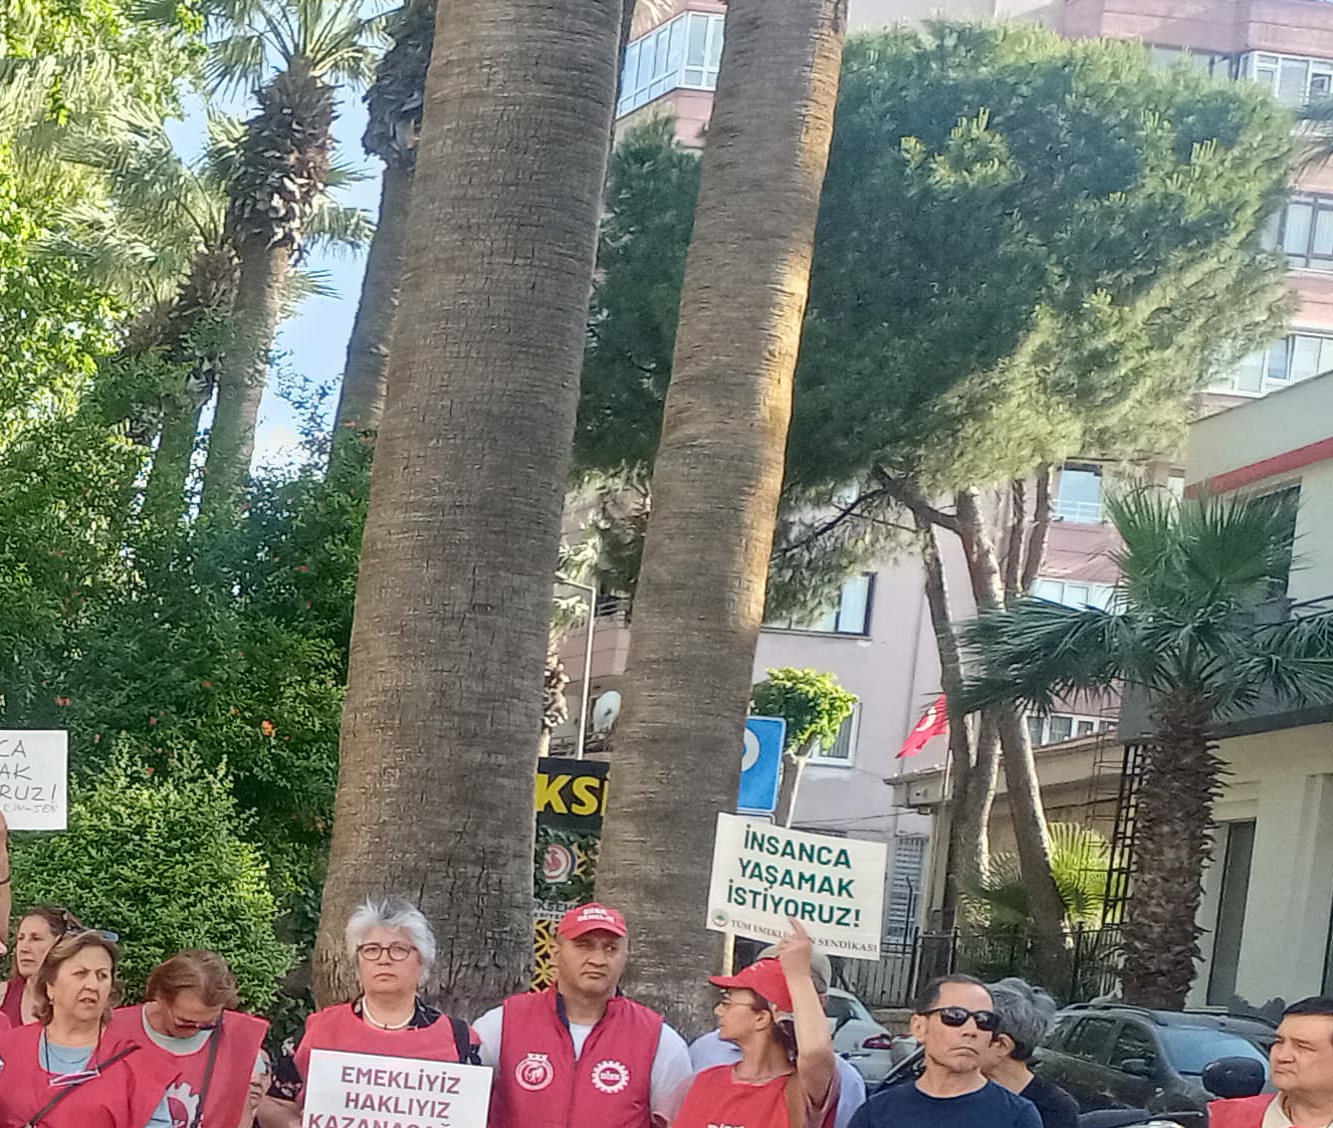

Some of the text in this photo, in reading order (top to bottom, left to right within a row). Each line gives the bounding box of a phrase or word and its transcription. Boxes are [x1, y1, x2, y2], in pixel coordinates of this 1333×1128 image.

[744, 824, 852, 869] İNSANCA
[739, 857, 855, 898] YAŞAMAK
[727, 879, 860, 928] İSTİYORUZ!
[341, 1065, 461, 1094] EMEKLİYİZ
[345, 1092, 451, 1119] HAKLIYIZ
